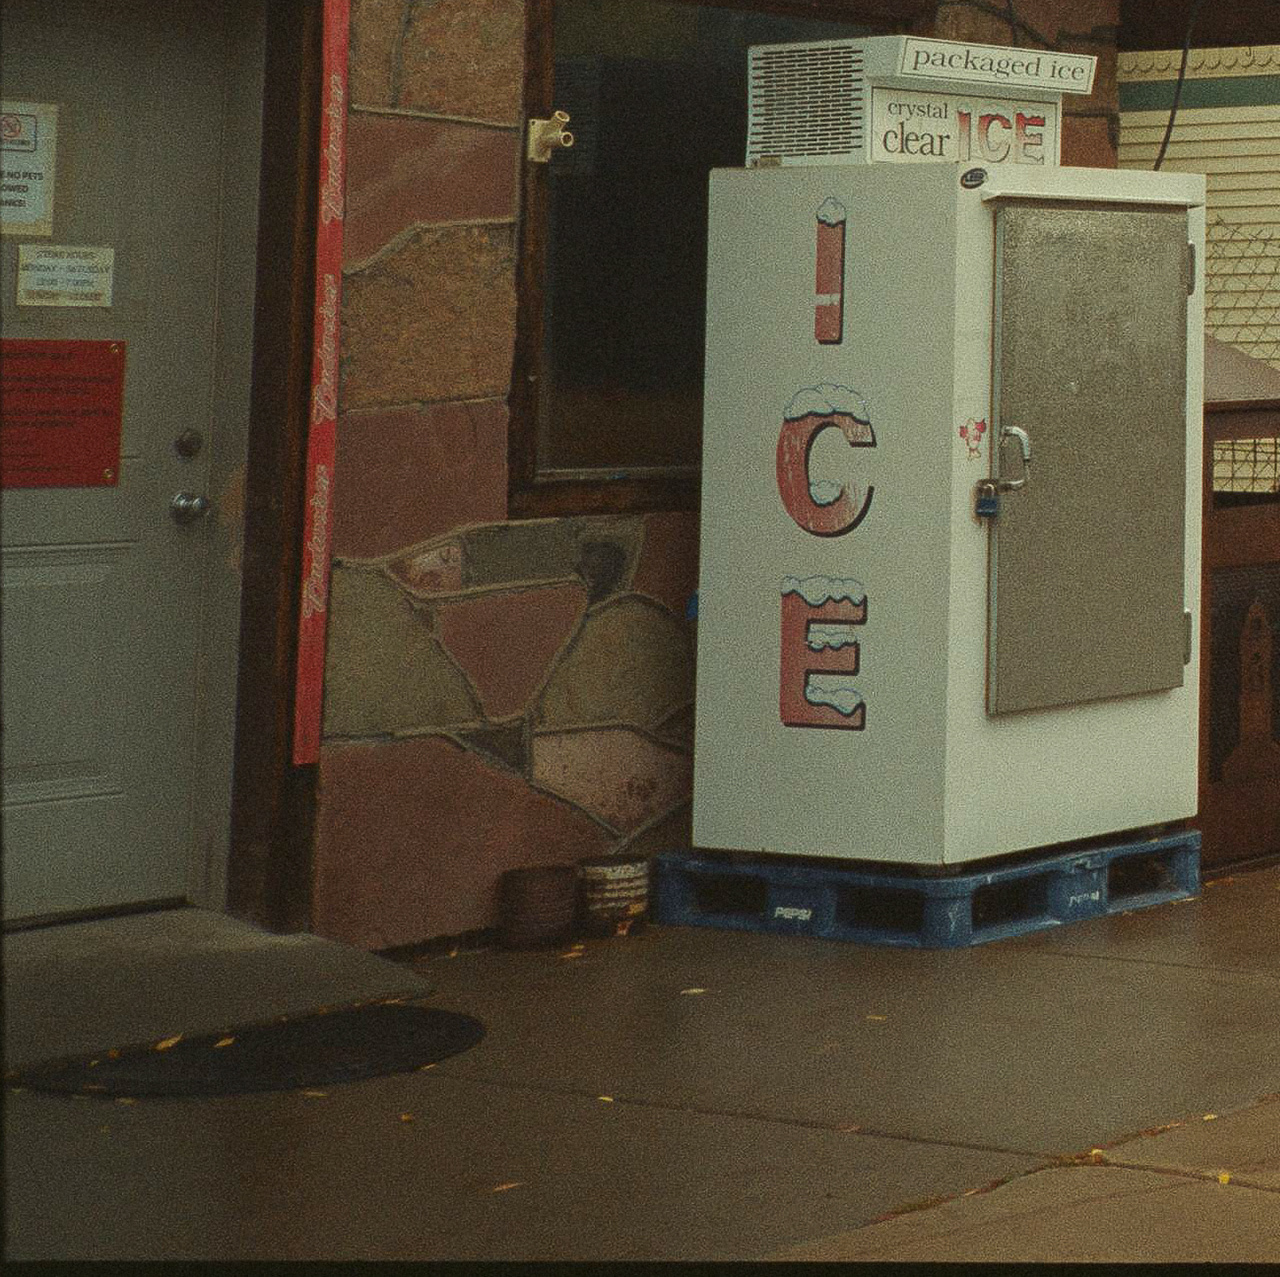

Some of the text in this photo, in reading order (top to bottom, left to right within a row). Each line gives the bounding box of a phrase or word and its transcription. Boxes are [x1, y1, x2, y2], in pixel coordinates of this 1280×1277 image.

[912, 49, 1085, 81] packaged ice
[887, 101, 949, 121] crystal
[882, 121, 951, 157] clear
[956, 103, 1046, 165] ICE
